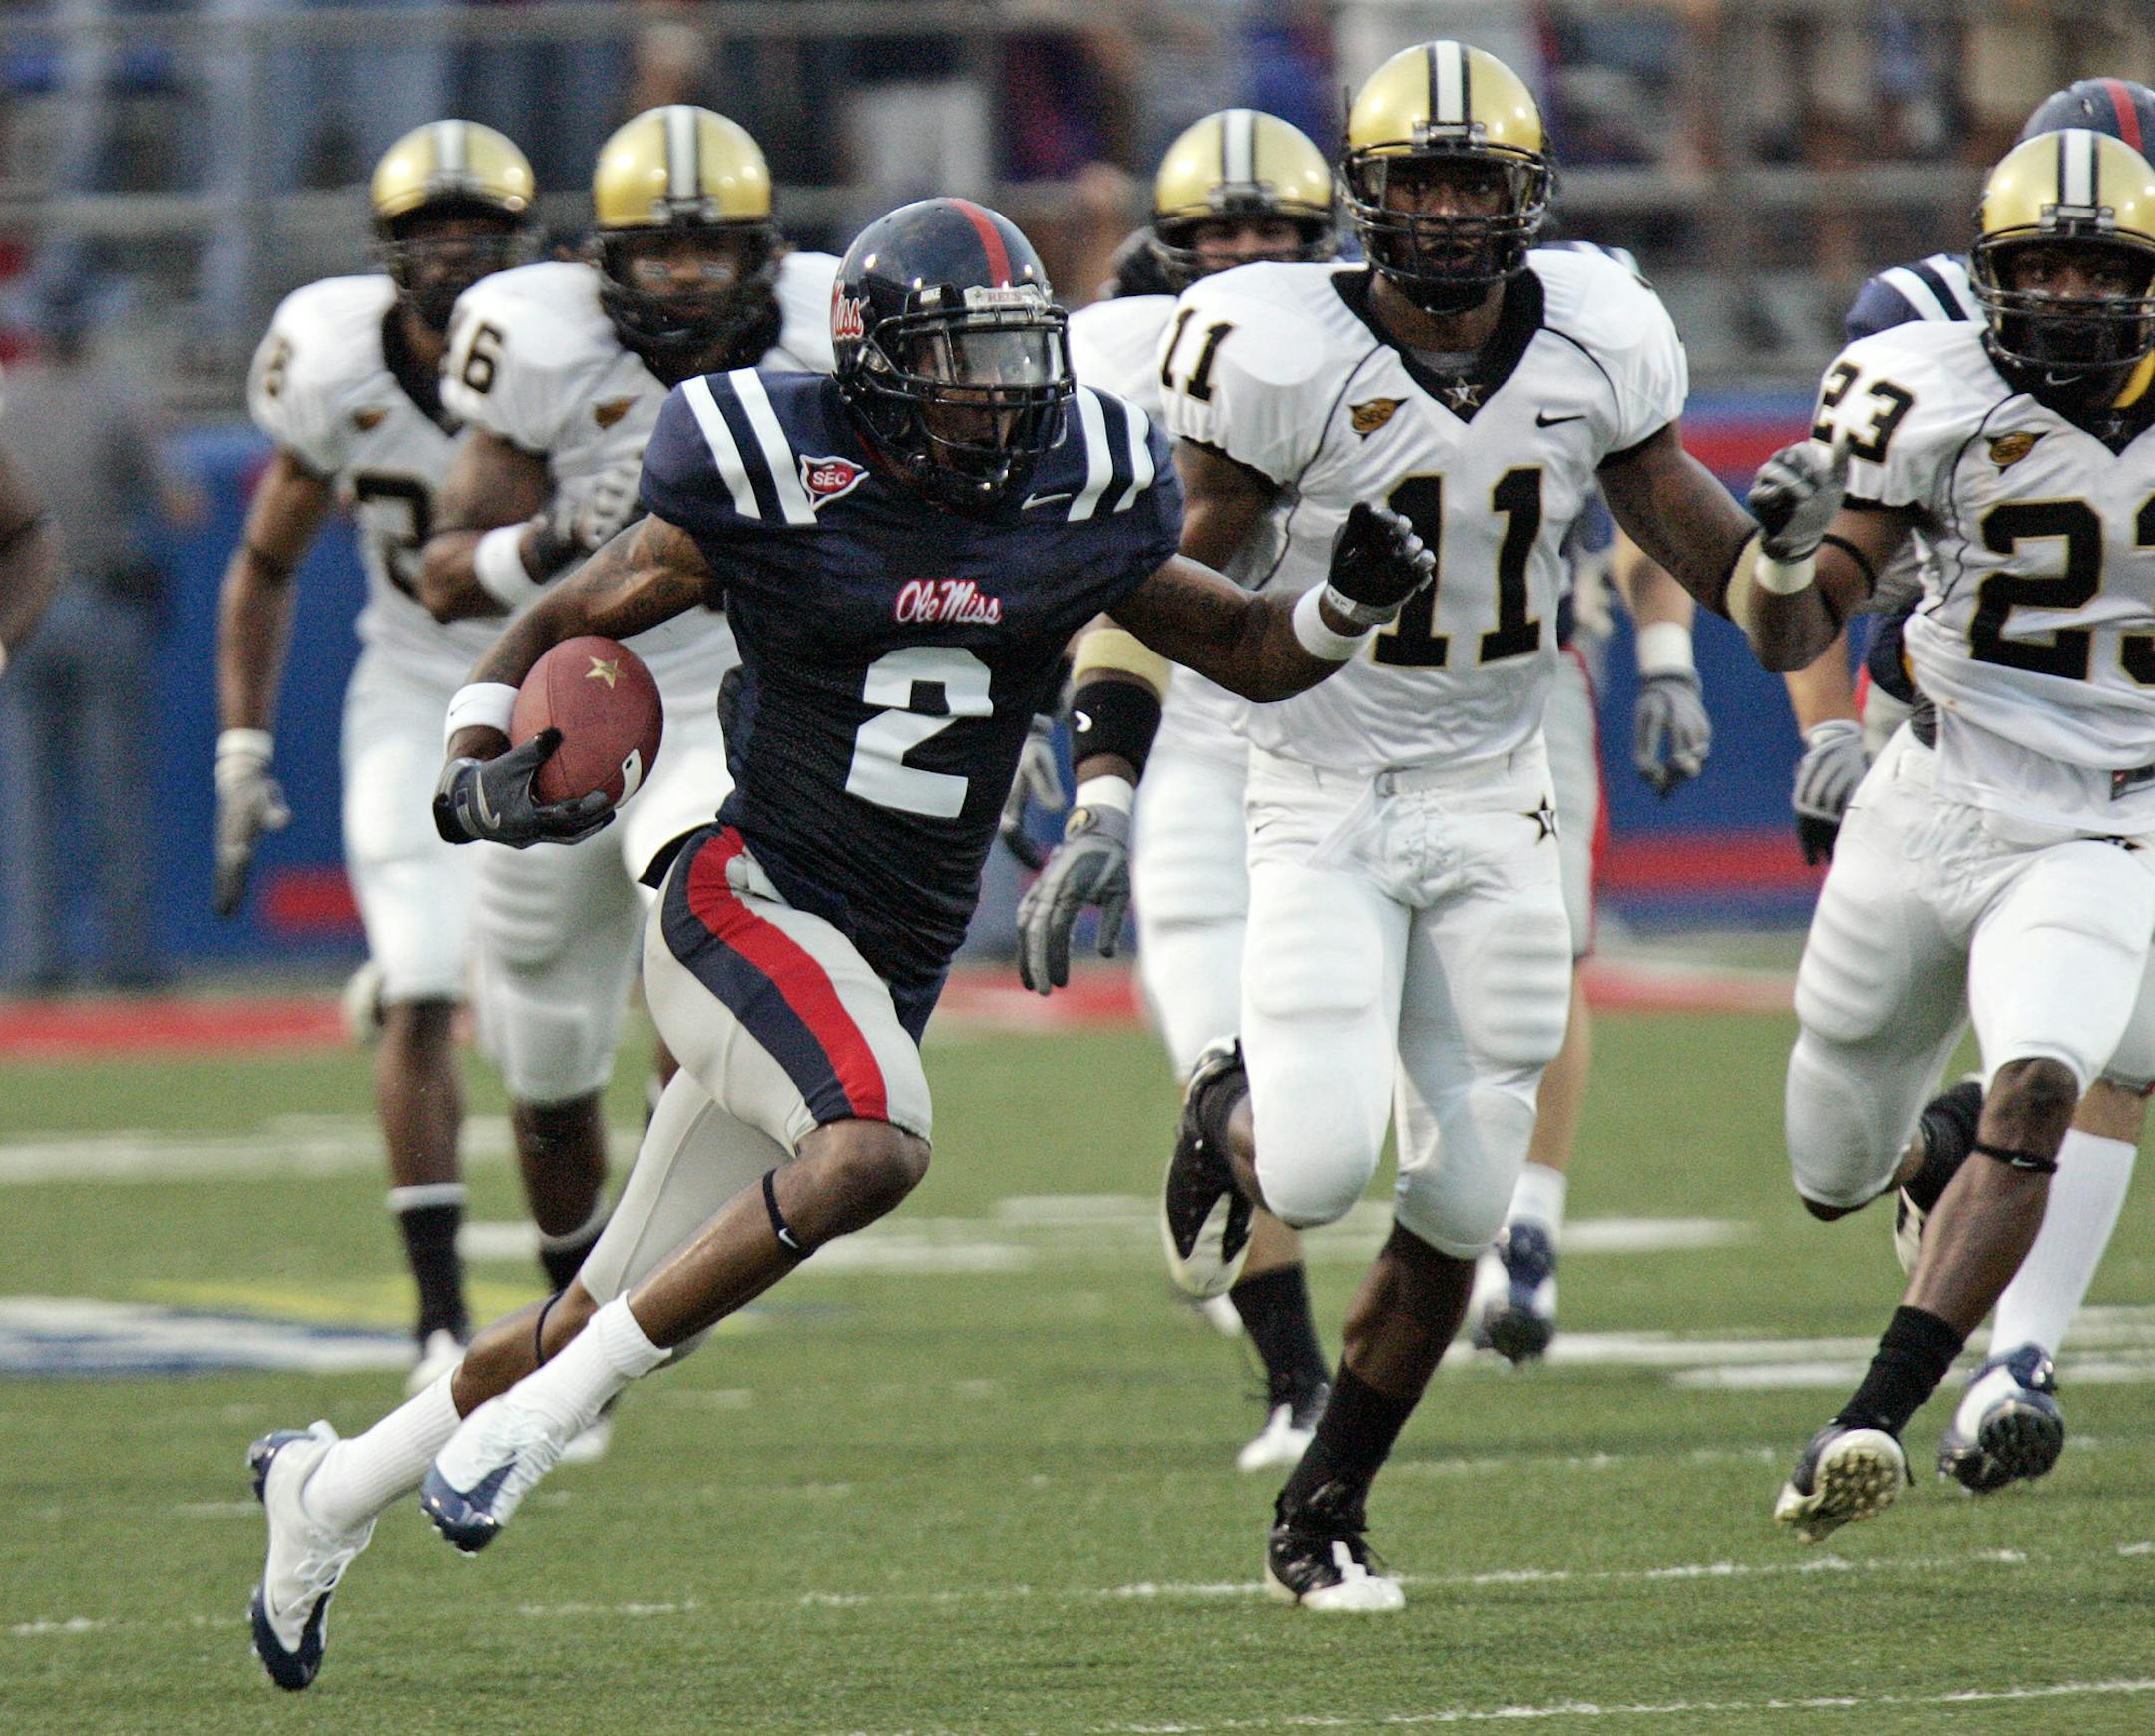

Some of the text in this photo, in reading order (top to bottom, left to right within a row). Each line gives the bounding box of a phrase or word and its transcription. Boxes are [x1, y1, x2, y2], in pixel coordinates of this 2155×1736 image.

[1161, 307, 1237, 403] 11
[1810, 360, 1917, 463] 23
[812, 469, 848, 487] SEC
[897, 578, 1001, 625] Ole Miss
[1370, 464, 1546, 669] 11
[1968, 491, 2155, 688] 2
[845, 647, 994, 819] 2
